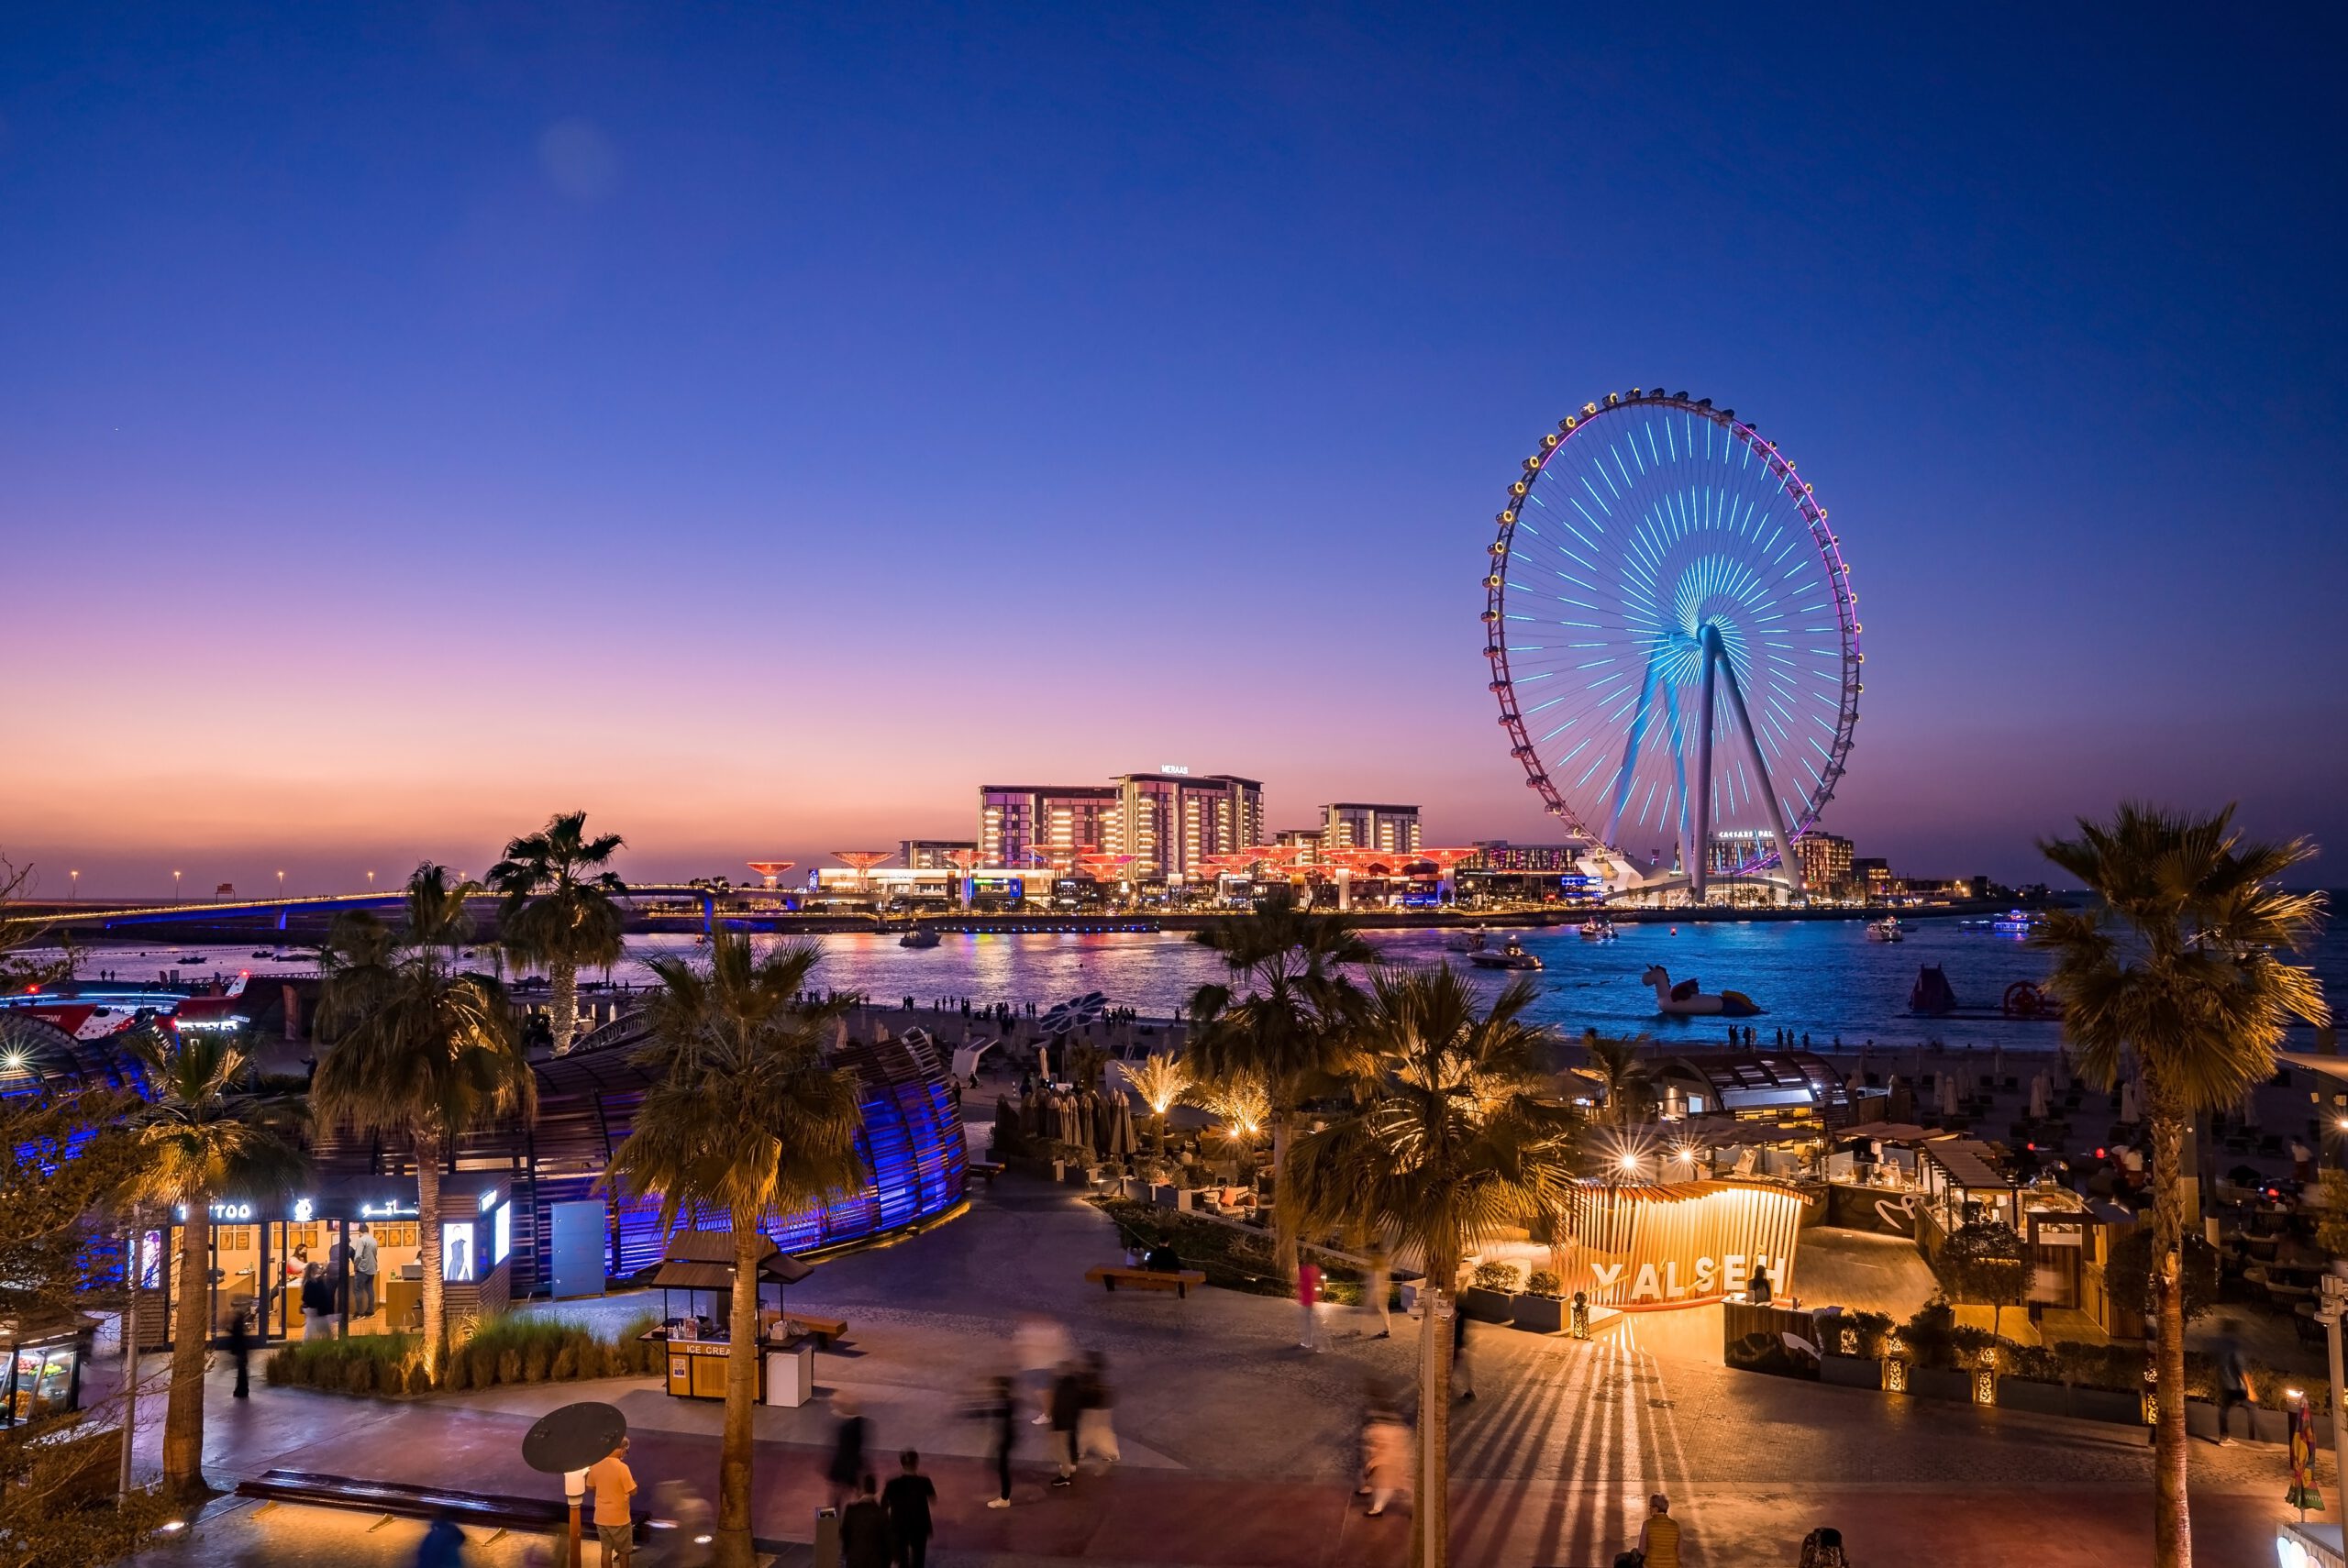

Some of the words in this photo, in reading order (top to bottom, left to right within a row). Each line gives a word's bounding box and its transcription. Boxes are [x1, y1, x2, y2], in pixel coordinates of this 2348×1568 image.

[179, 1204, 251, 1220] TTOO
[1590, 1255, 1786, 1301] YALSEH
[686, 1344, 702, 1354] ICE
[705, 1346, 731, 1355] CREA
